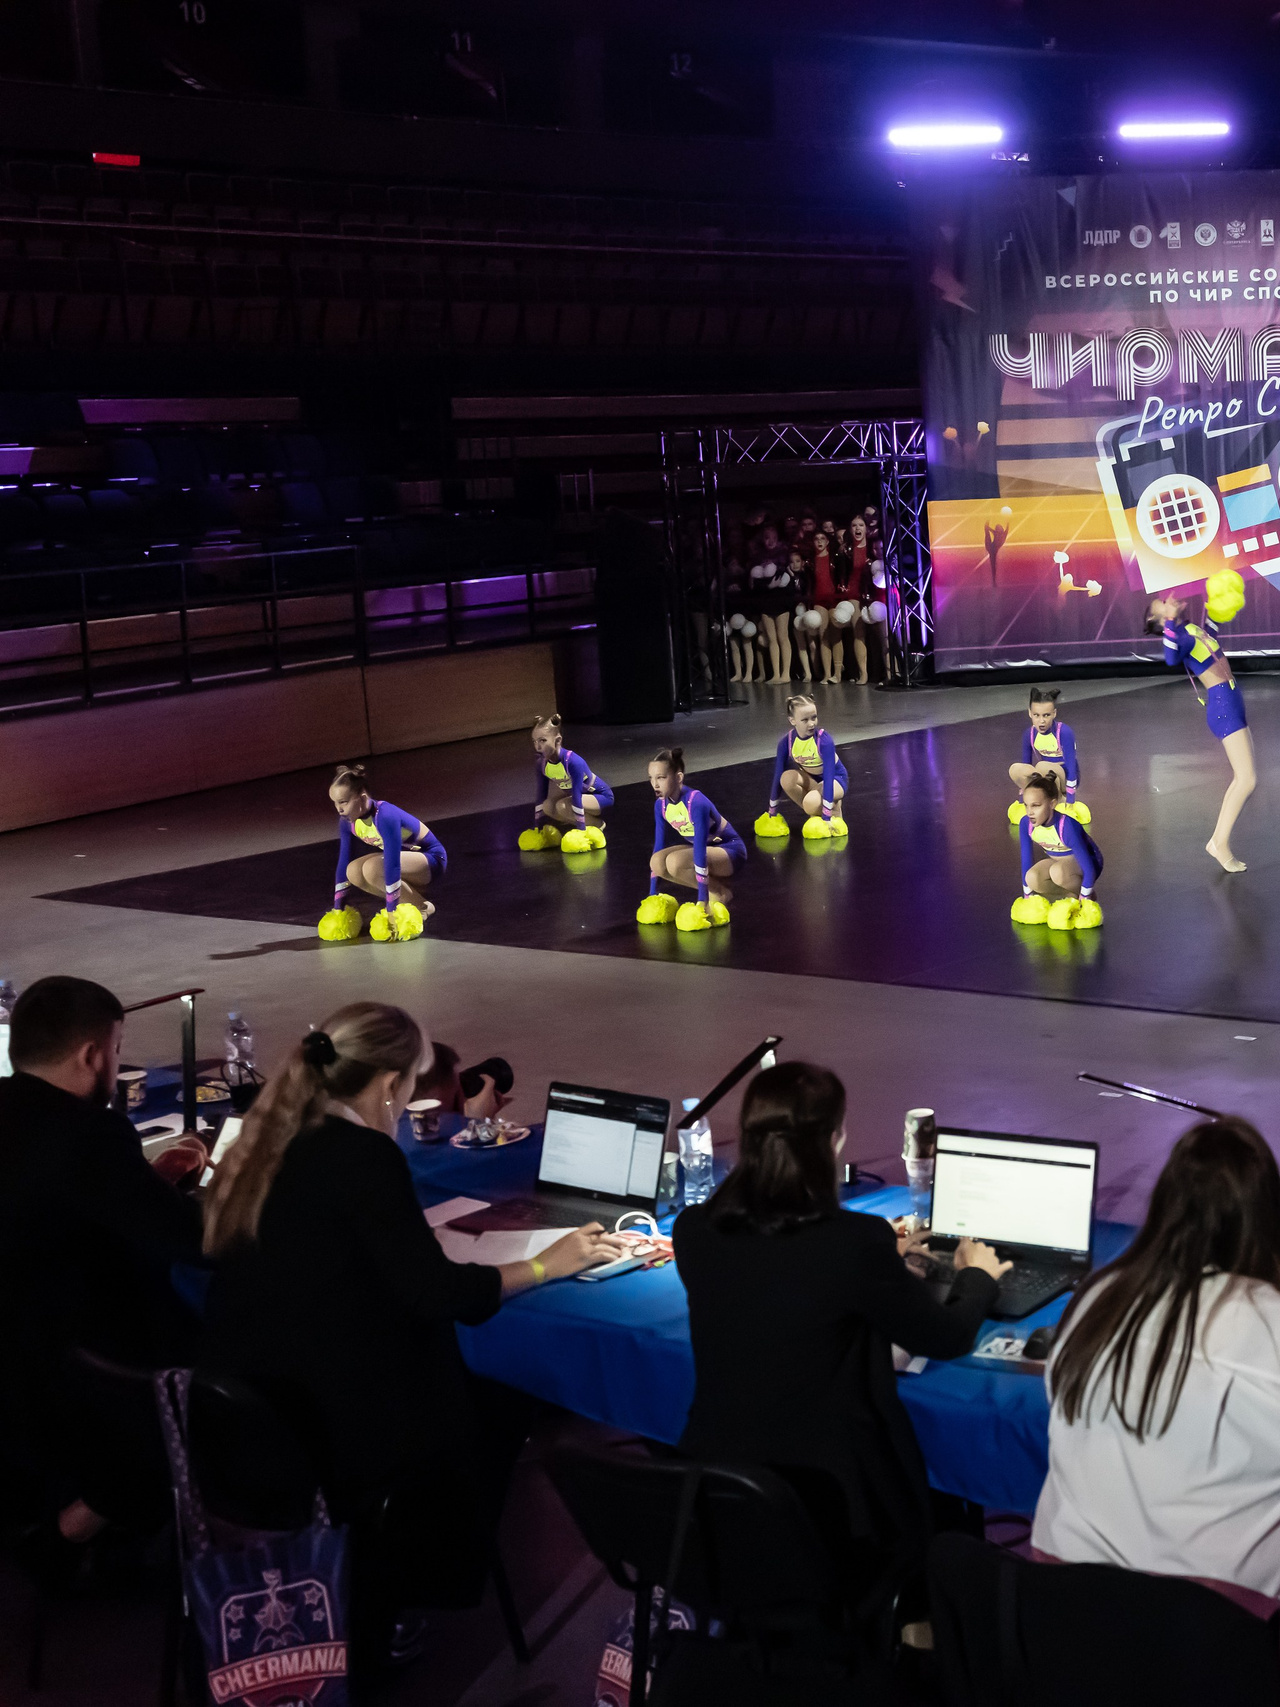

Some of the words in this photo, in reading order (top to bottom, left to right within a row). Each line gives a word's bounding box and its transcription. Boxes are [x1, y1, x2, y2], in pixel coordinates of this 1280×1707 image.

[177, 0, 206, 24] 10
[450, 30, 473, 52] 11
[1083, 228, 1121, 247] ЛДПР
[1045, 268, 1239, 290] ВСЕРОССИЙСКИЕ
[1148, 289, 1179, 304] ПО
[1189, 287, 1233, 302] ЧИР
[1137, 395, 1243, 438] Ретро
[212, 1646, 348, 1698] CHEERMANIA
